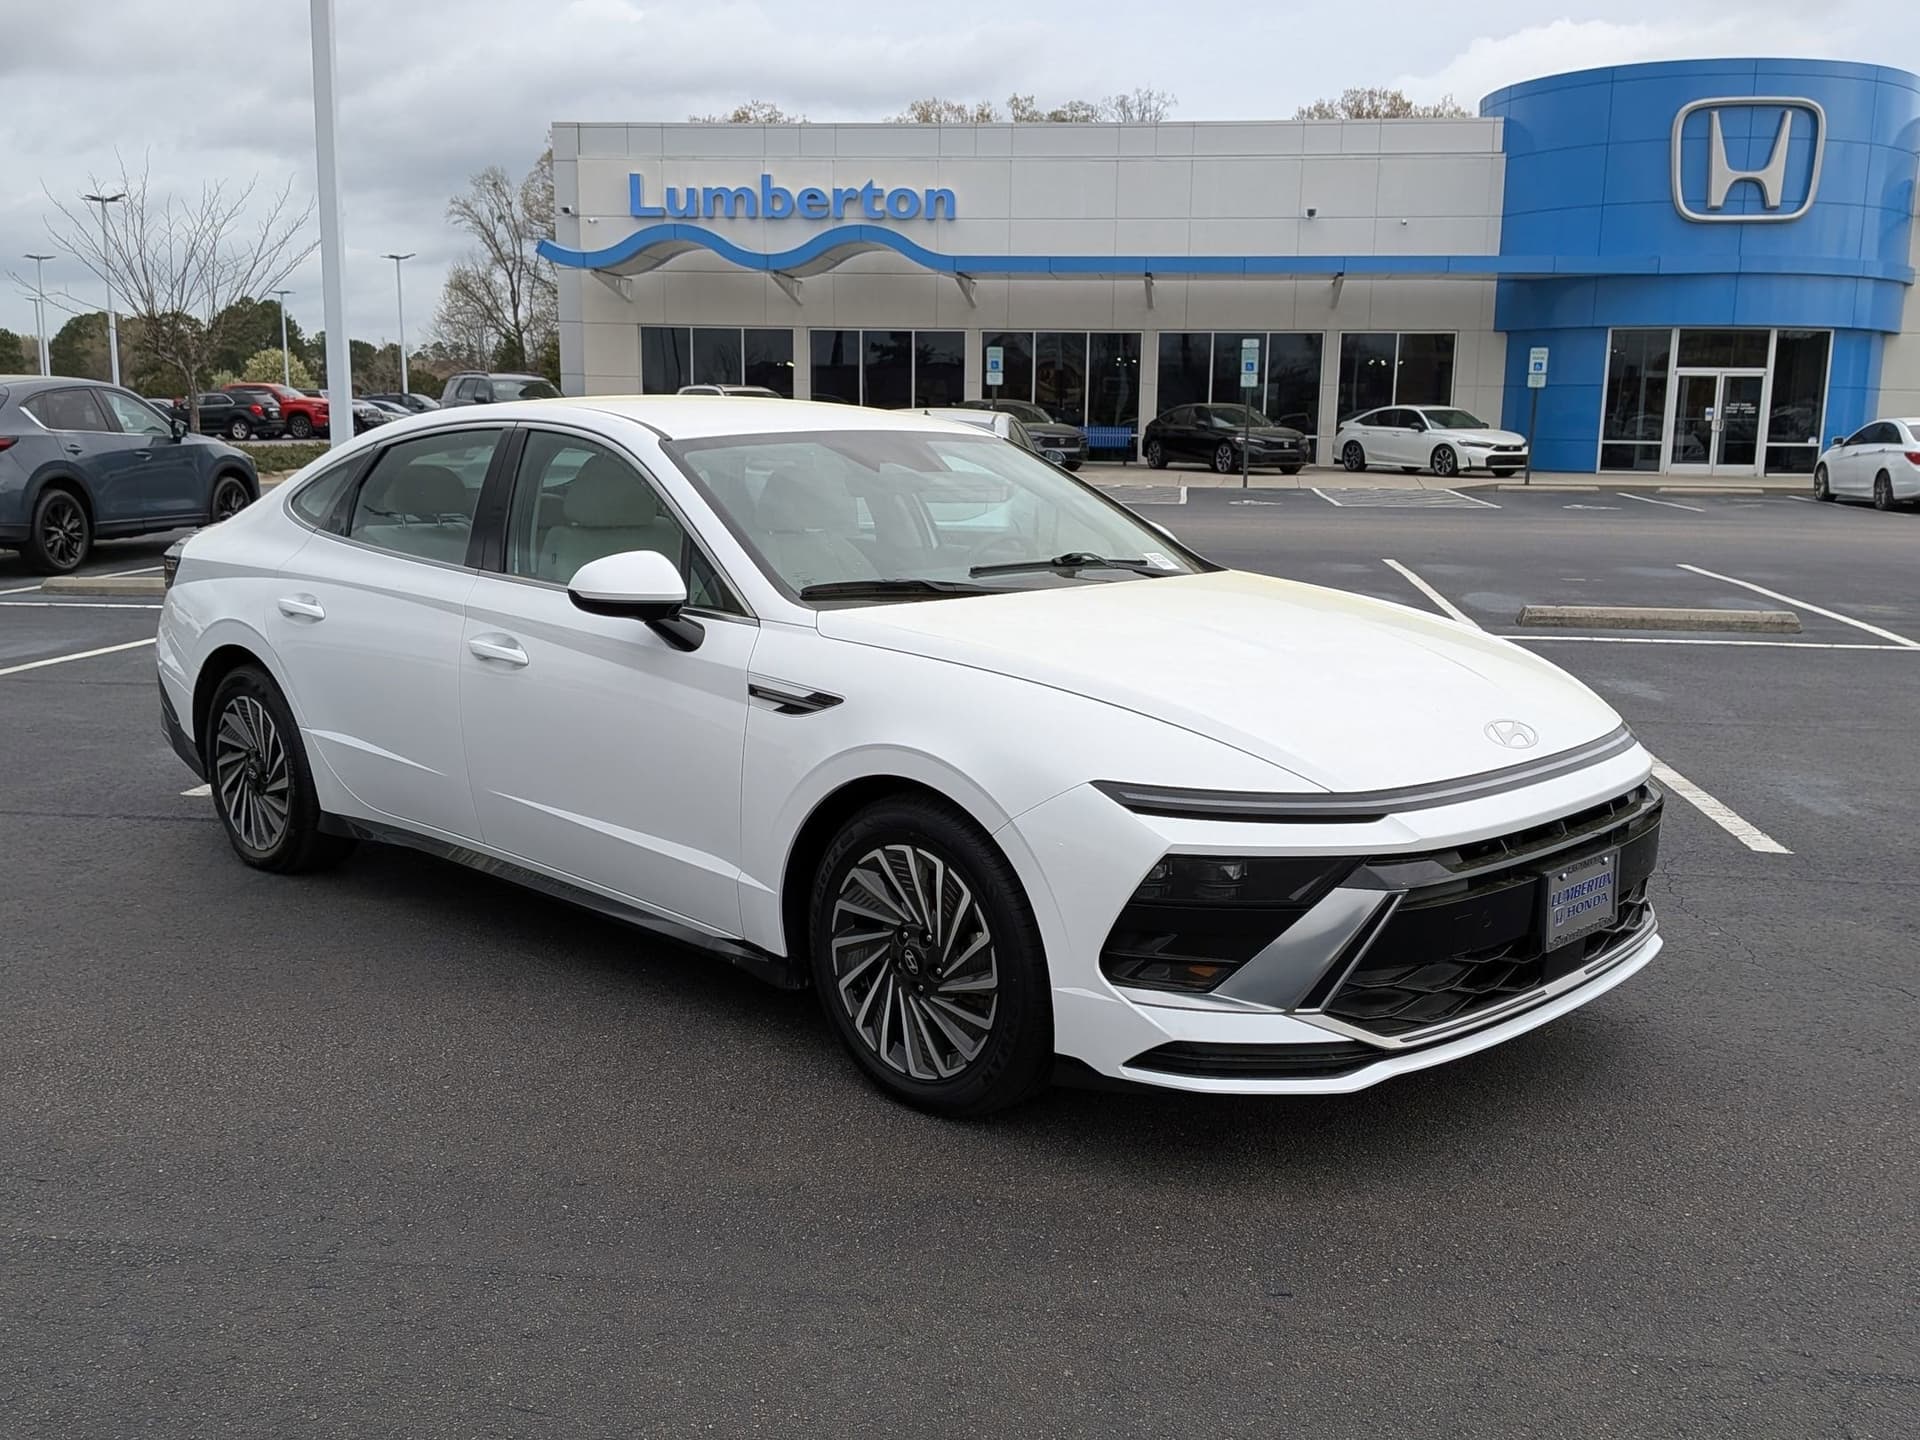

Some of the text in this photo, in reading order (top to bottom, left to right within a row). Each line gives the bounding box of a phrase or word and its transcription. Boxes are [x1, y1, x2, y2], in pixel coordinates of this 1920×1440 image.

[628, 173, 956, 221] Lumberton
[1551, 872, 1612, 907] LUMBERTON
[1567, 893, 1609, 917] HONDA
